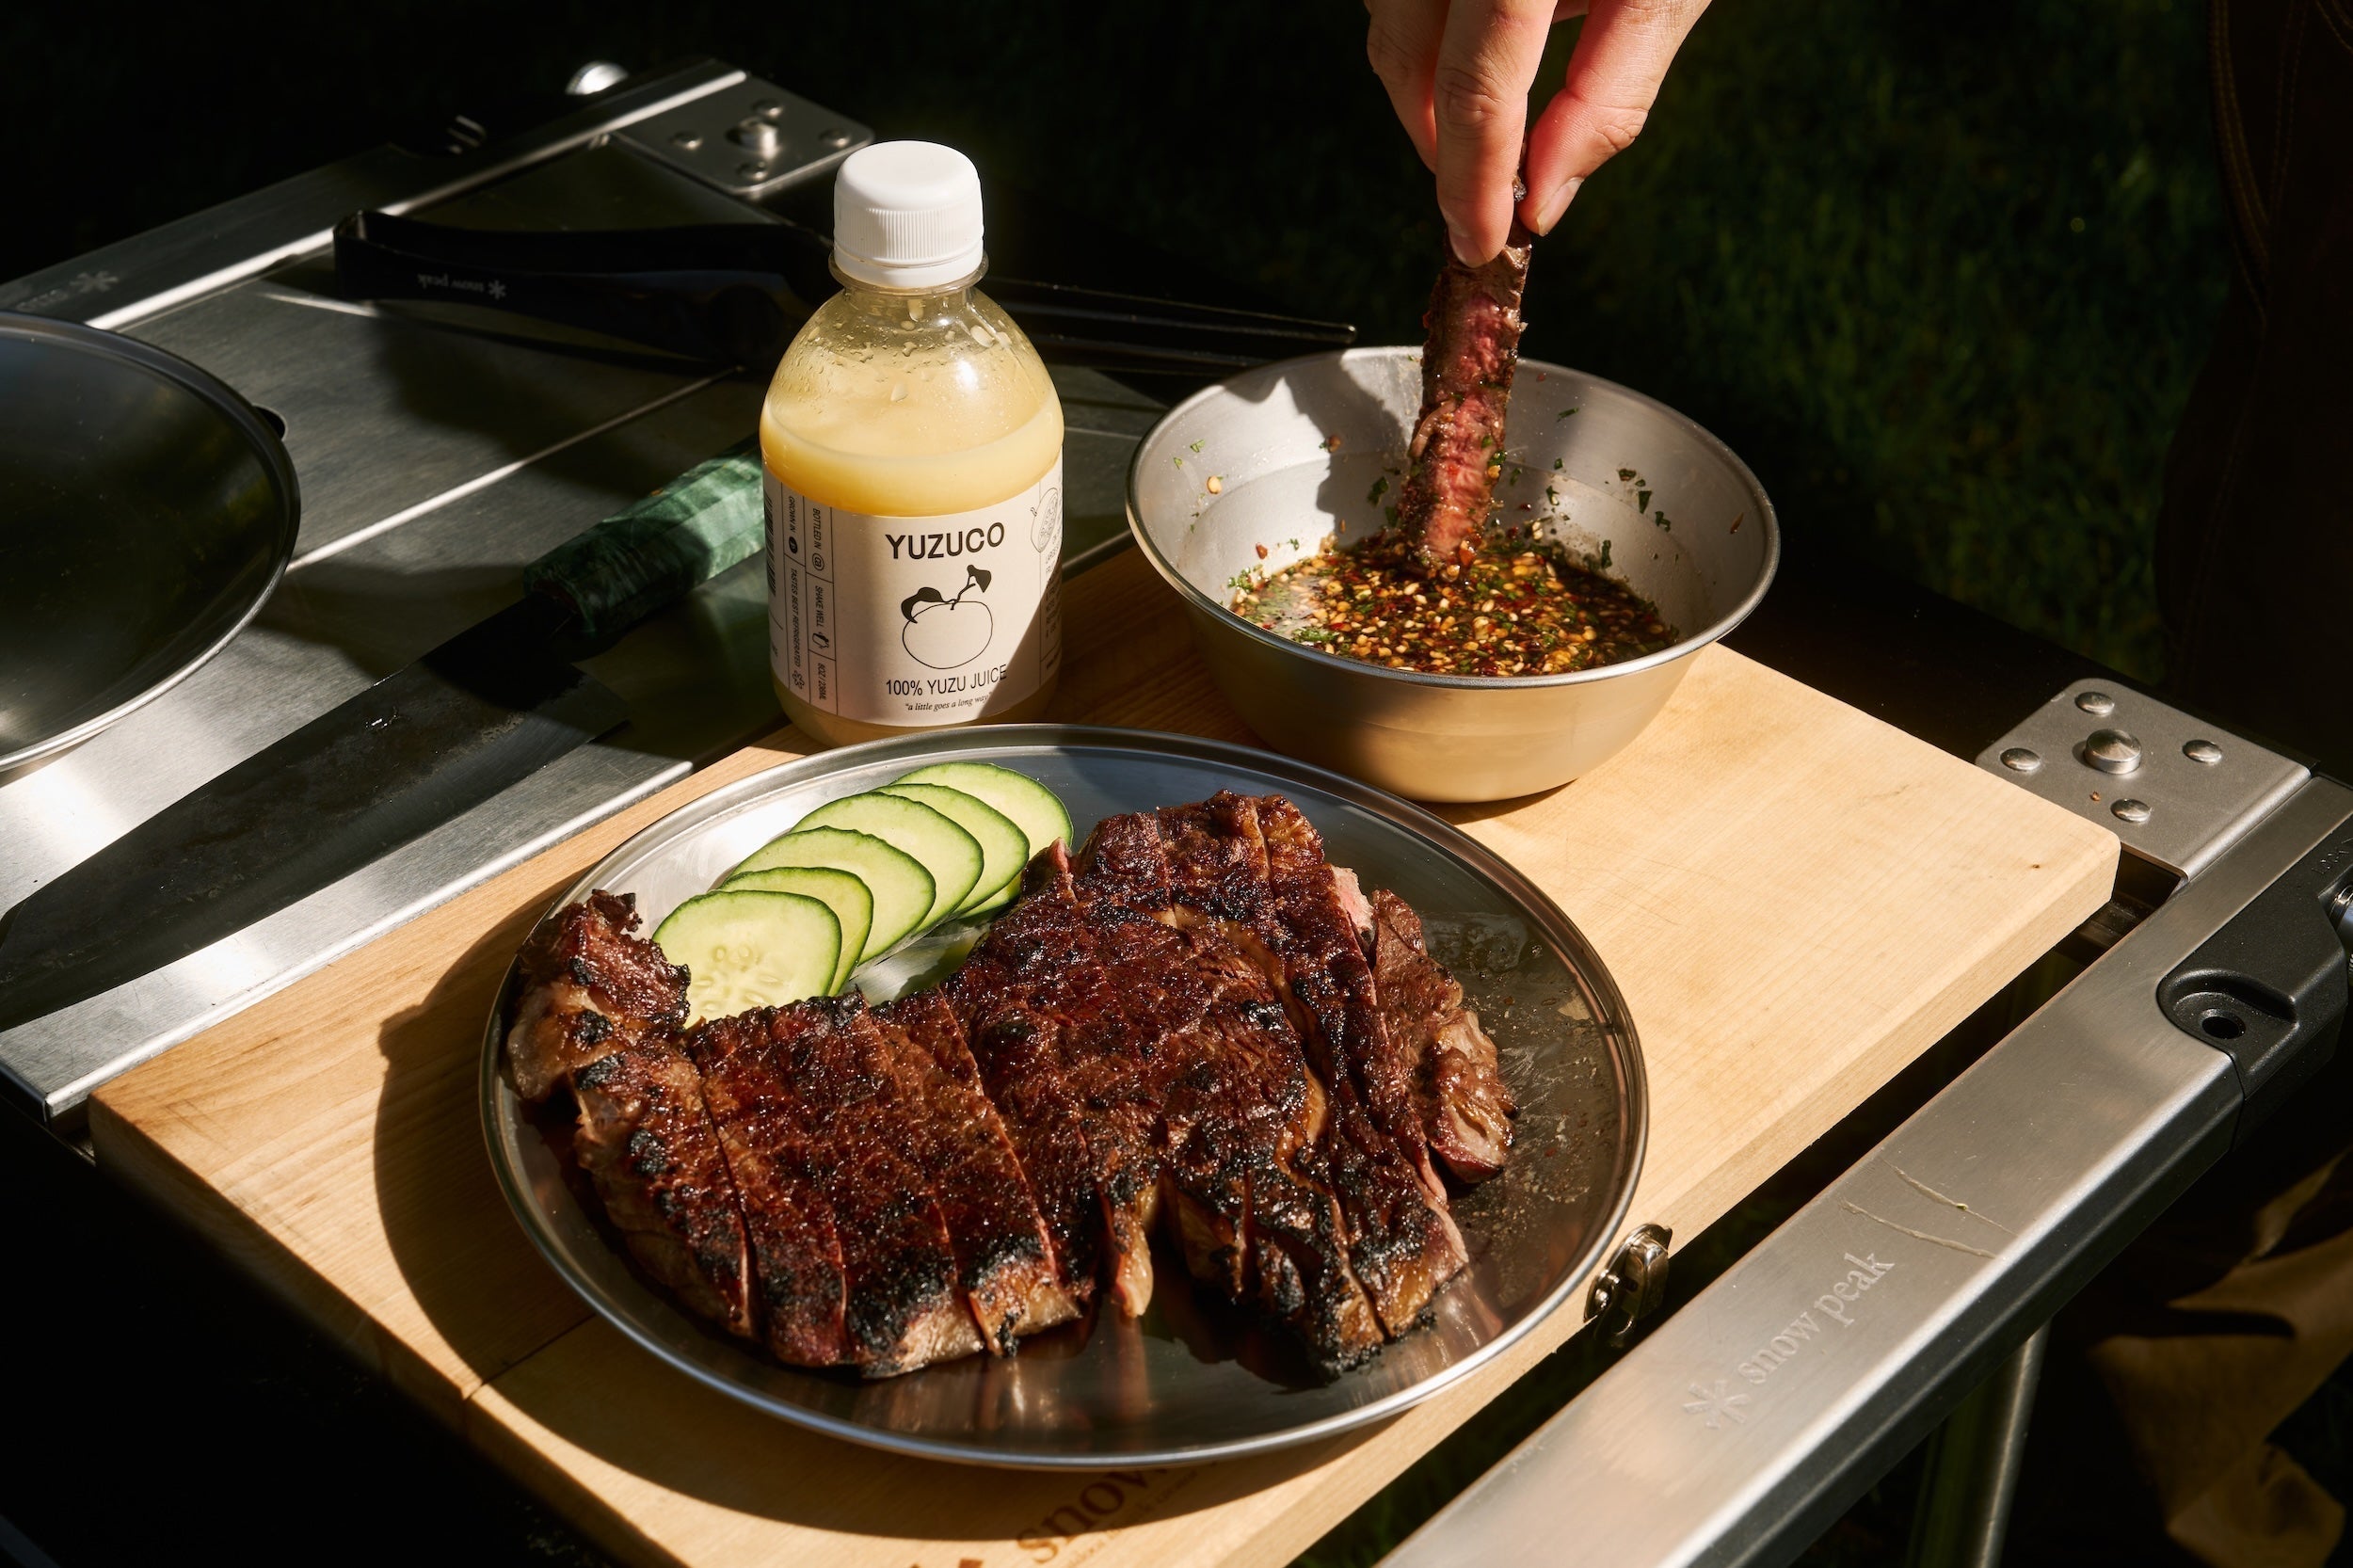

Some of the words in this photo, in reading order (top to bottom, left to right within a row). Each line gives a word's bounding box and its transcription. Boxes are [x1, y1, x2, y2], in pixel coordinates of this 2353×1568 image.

[788, 495, 796, 525] GROWN
[812, 508, 822, 541] BOTTLED
[885, 521, 1005, 559] YUZUCO
[791, 568, 799, 594] TASTES
[815, 585, 824, 609] SHAKE
[816, 610, 824, 627] WELL
[886, 680, 923, 696] 100%
[927, 676, 966, 695] YUZU
[970, 664, 1007, 689] JUICE
[915, 701, 932, 711] little
[934, 703, 950, 712] goes
[958, 697, 973, 708] long
[1737, 1311, 1820, 1384] snow
[1814, 1252, 1896, 1327] peak
